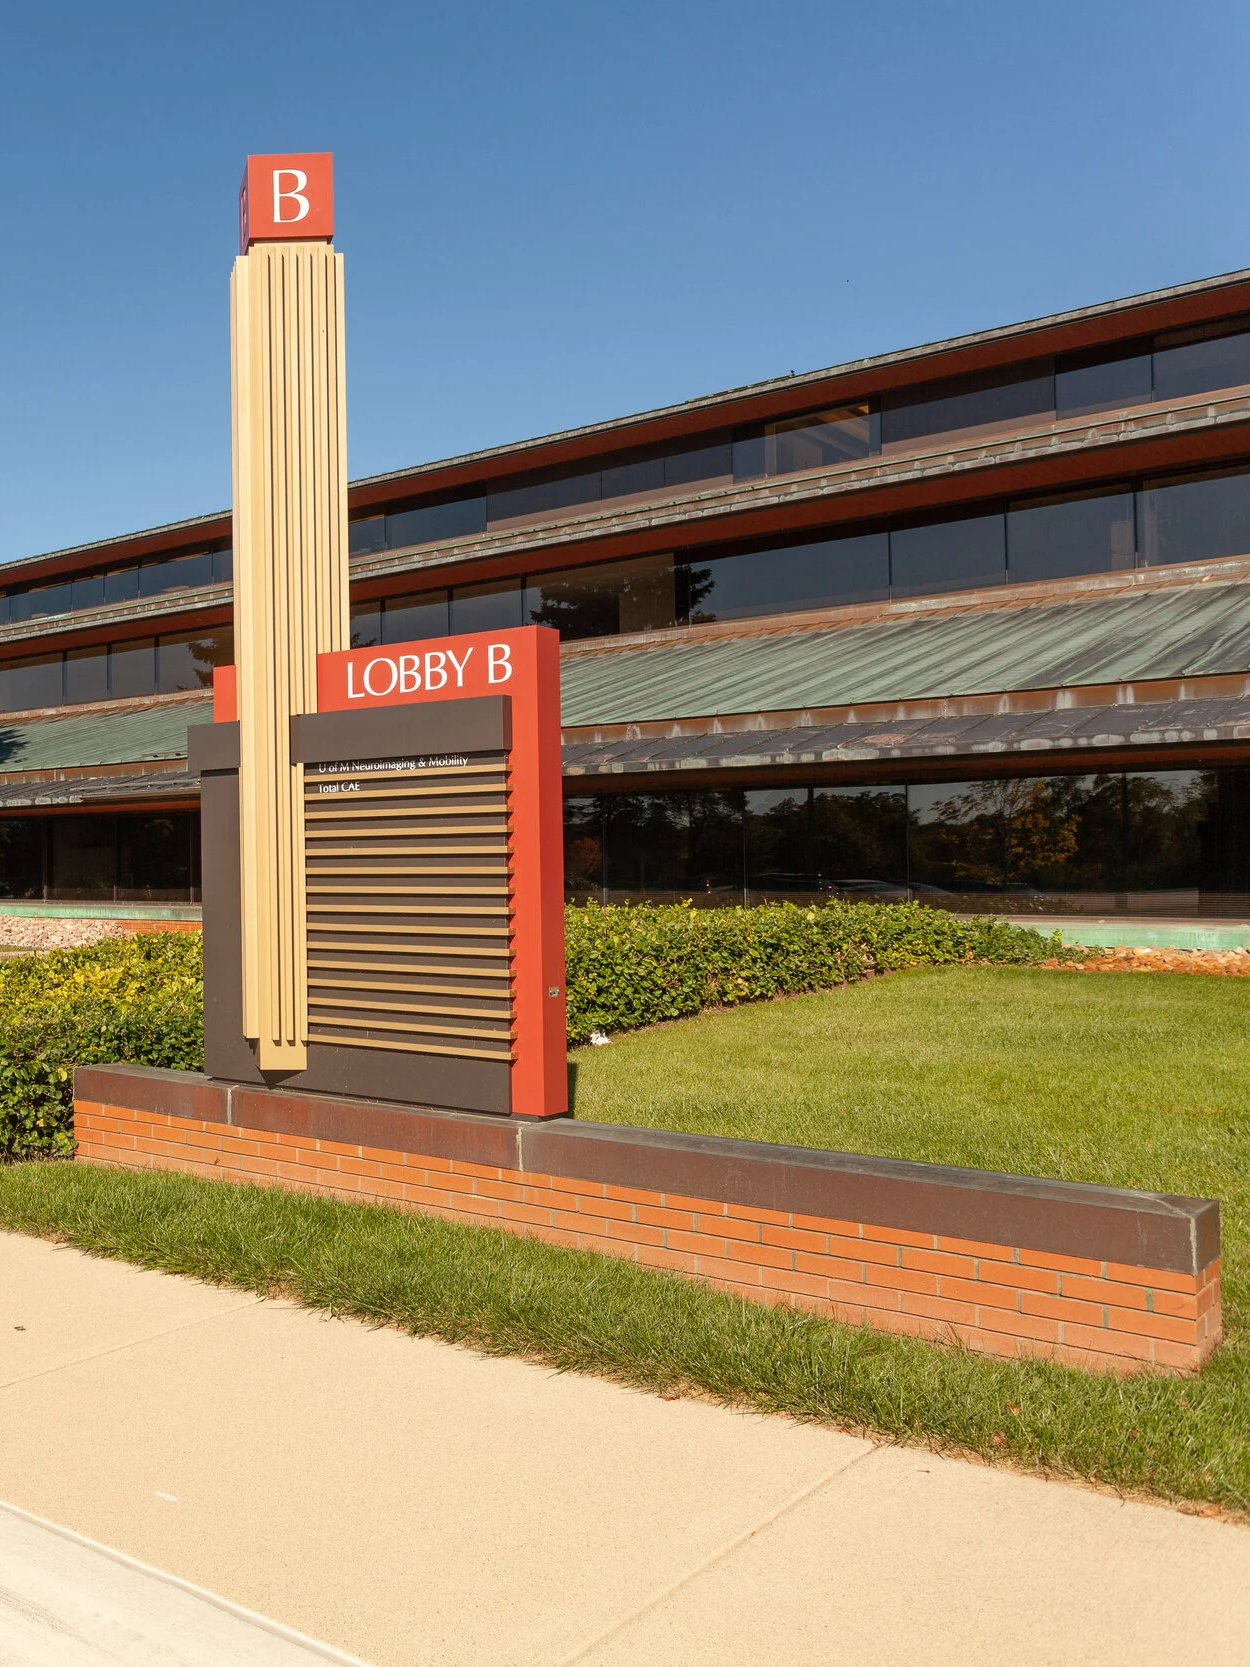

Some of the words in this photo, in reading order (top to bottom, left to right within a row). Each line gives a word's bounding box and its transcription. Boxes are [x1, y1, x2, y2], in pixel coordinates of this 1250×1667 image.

[272, 169, 310, 223] B
[347, 646, 474, 699] LOBBY
[488, 643, 513, 685] B
[318, 763, 326, 773] U
[328, 761, 338, 772] of
[339, 761, 350, 772] M
[351, 758, 416, 771] Neuroimaging
[418, 757, 426, 767] &
[428, 754, 469, 767] Mobility
[318, 782, 339, 793] Total
[341, 781, 360, 792] CAE
